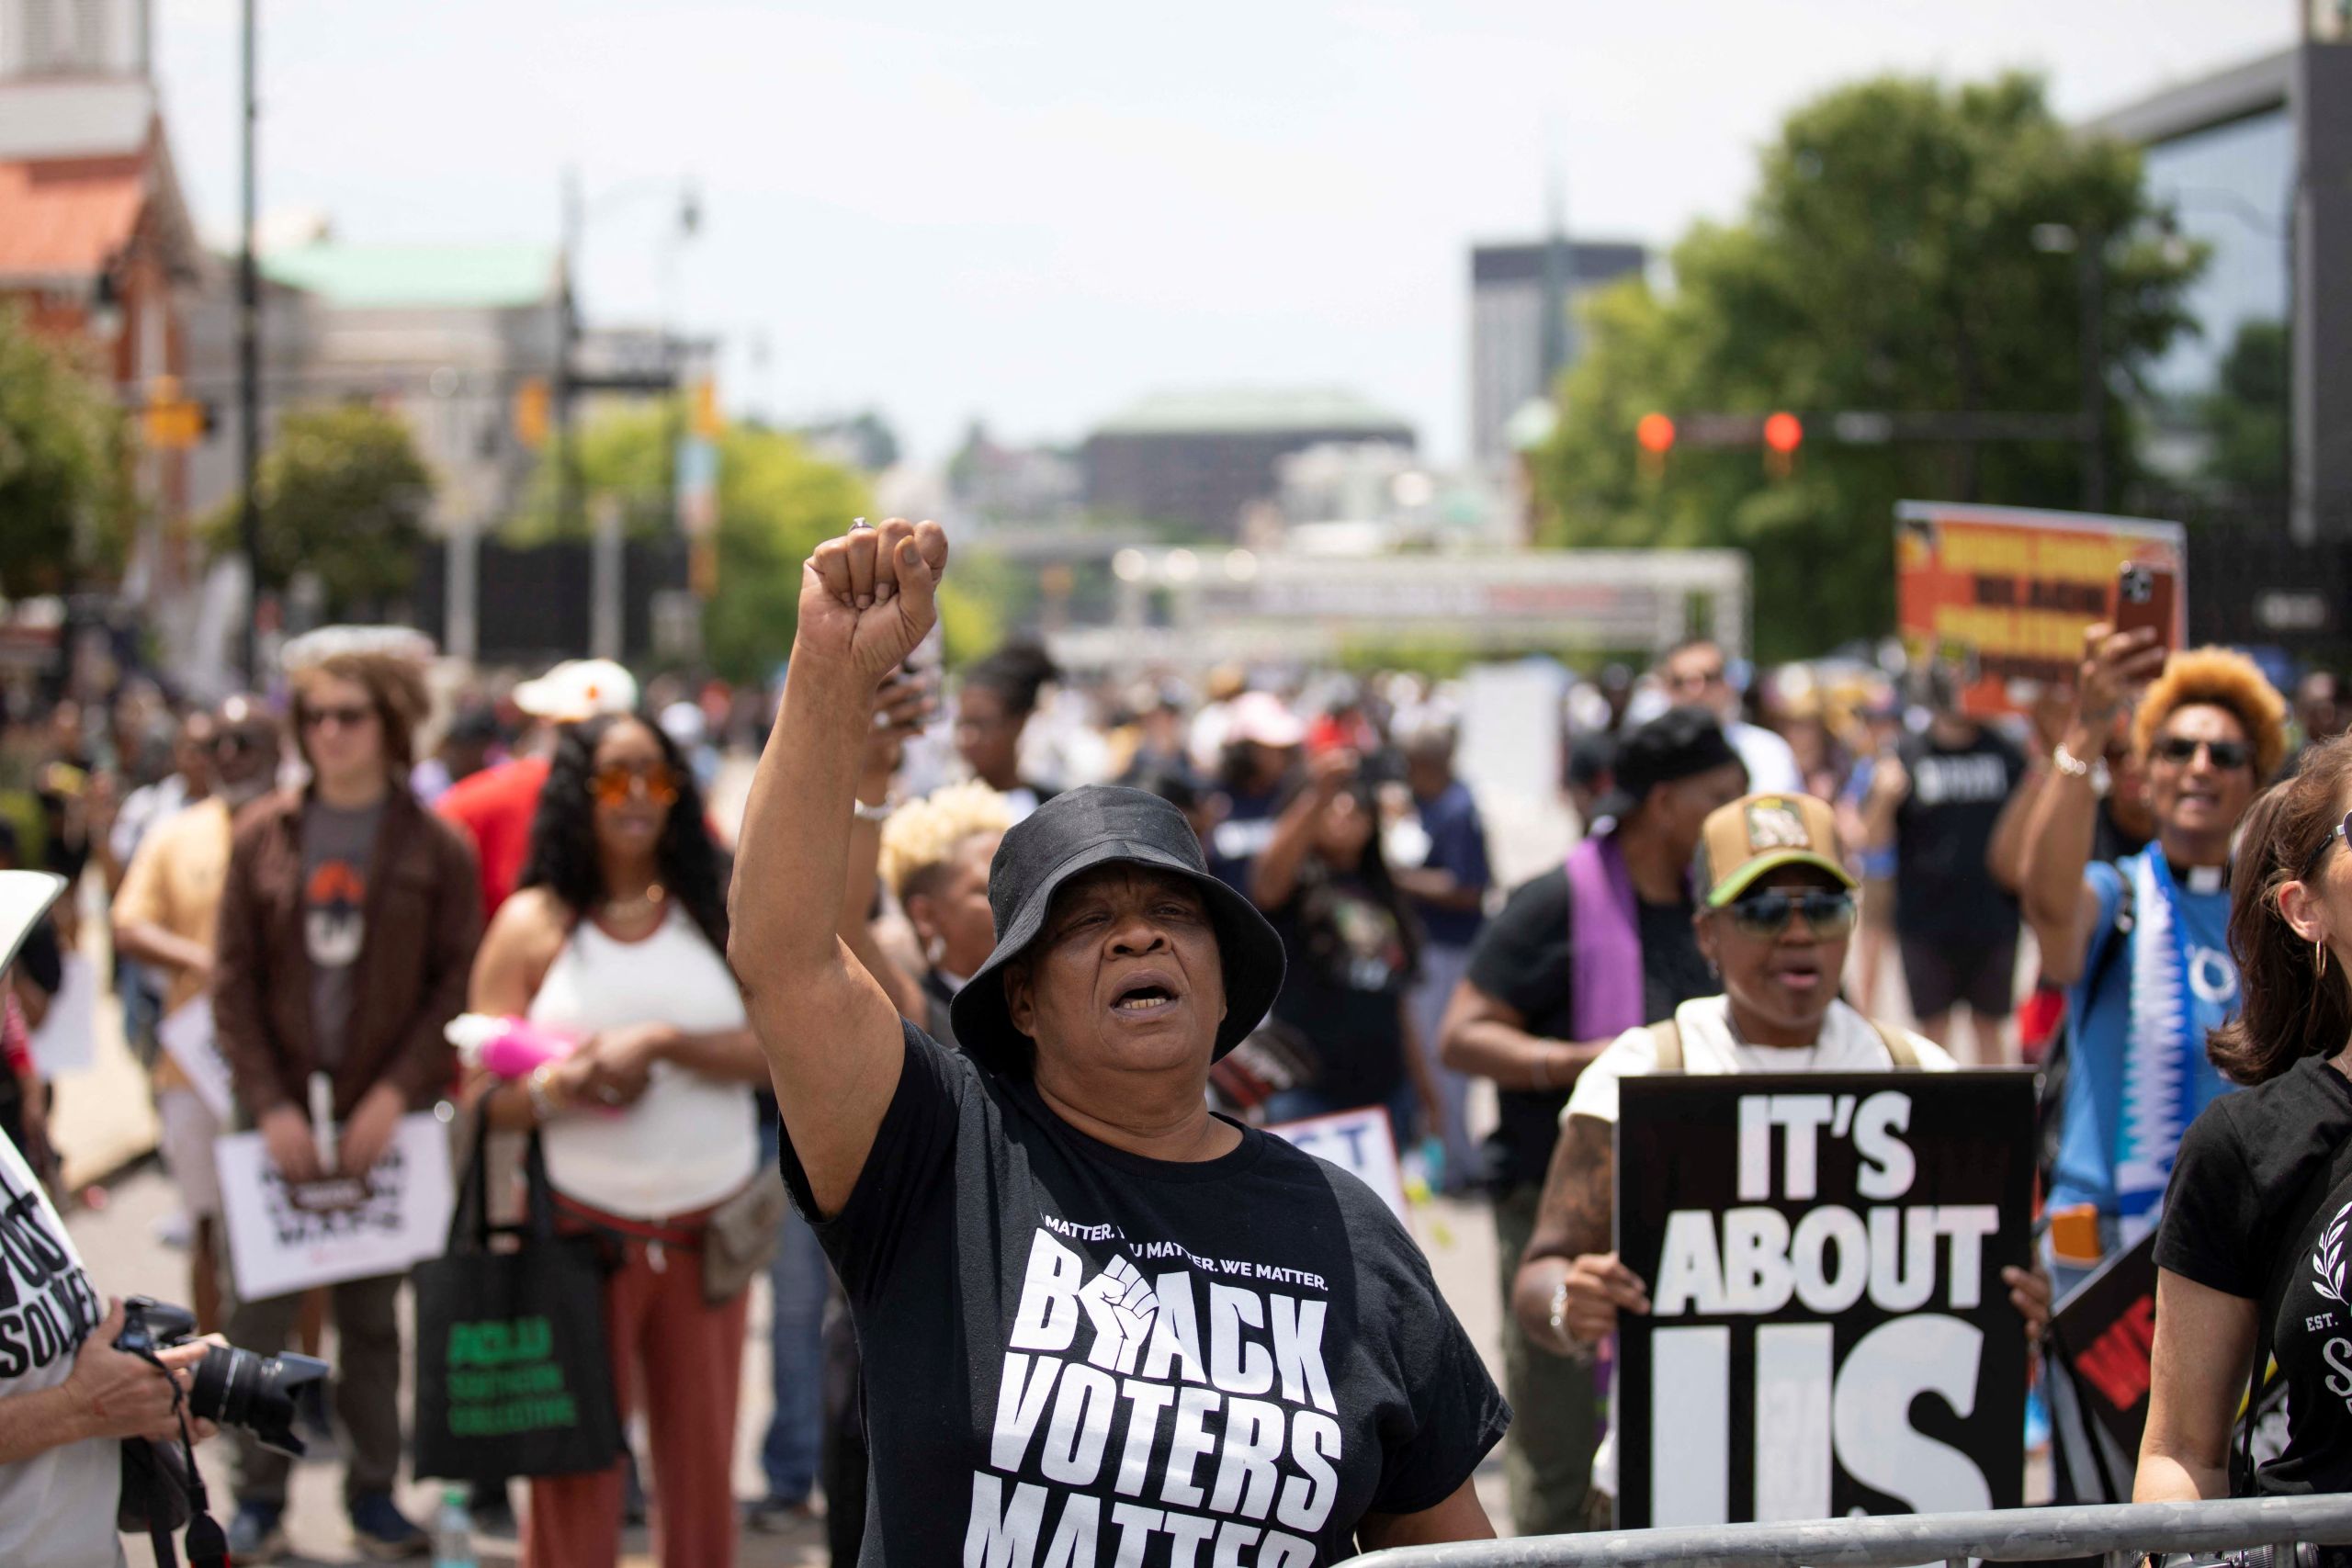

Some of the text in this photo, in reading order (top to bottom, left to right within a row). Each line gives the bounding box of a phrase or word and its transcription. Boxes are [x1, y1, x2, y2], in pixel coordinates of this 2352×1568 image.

[1738, 1091, 1916, 1201] IT'S
[1045, 1214, 1329, 1292] MATTER. MATER. WE MATTER.
[1651, 1204, 1999, 1315] ABOUT
[2305, 1312, 2339, 1332] EST.
[990, 1351, 1342, 1533] VOTERS
[1651, 1314, 1993, 1568] US
